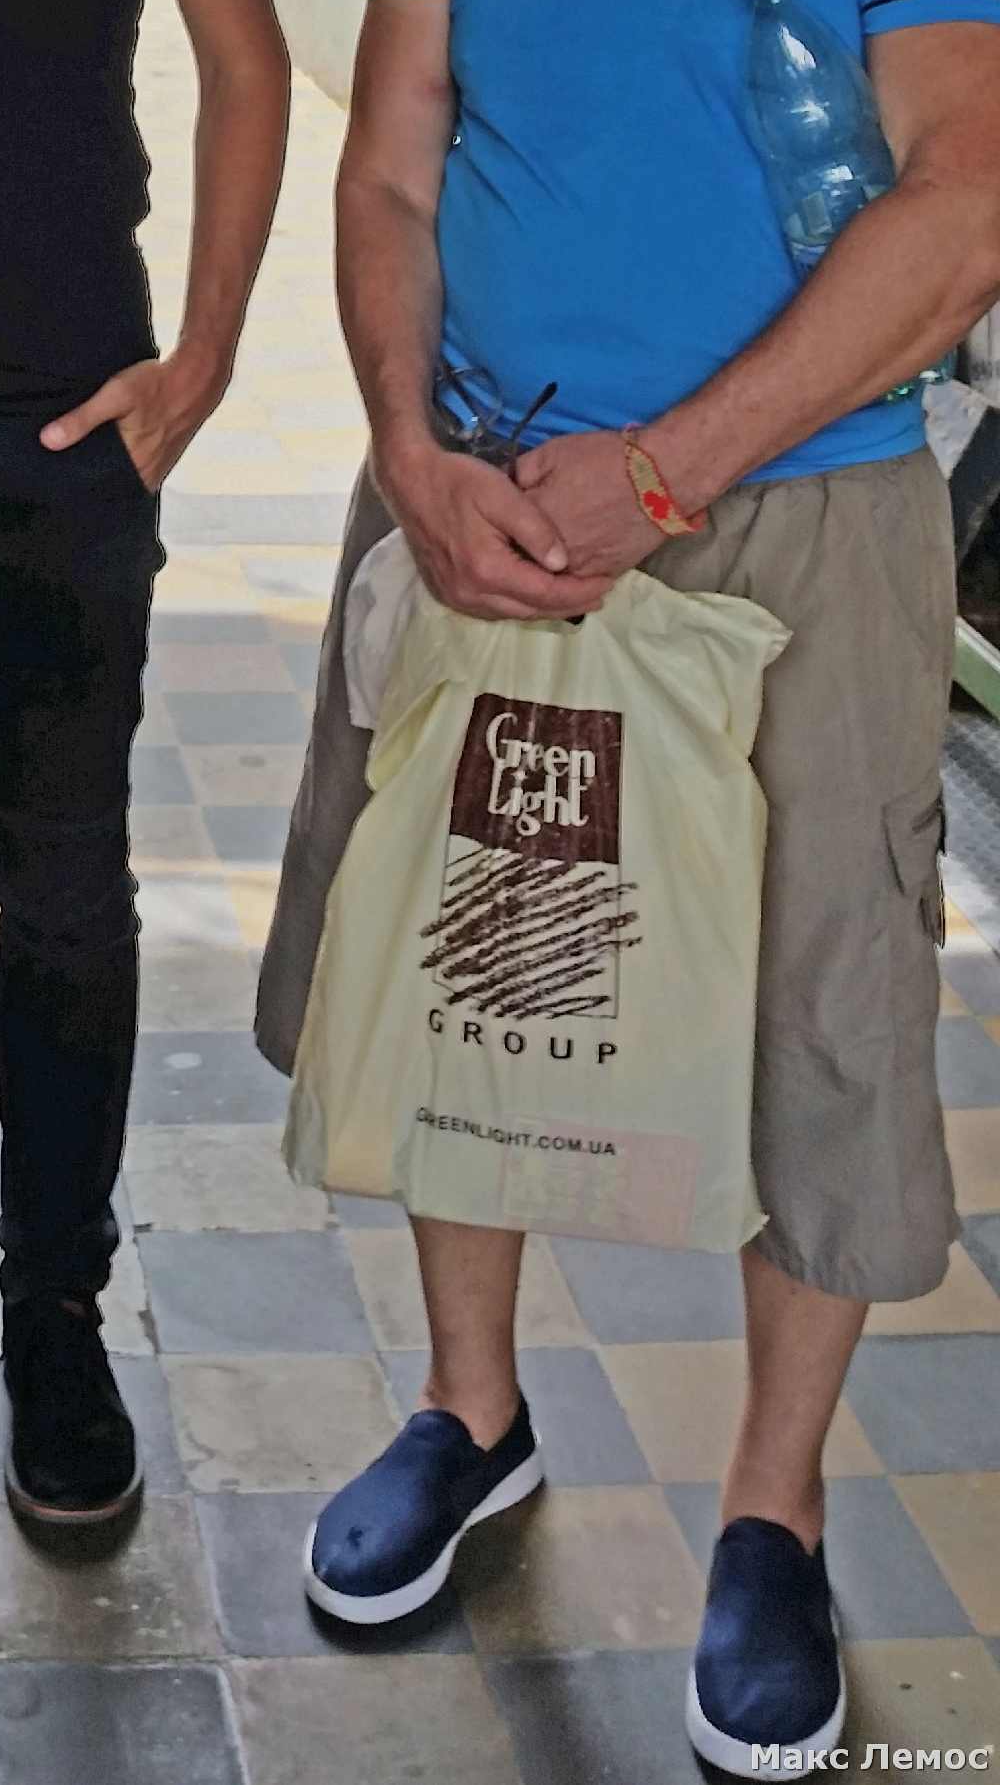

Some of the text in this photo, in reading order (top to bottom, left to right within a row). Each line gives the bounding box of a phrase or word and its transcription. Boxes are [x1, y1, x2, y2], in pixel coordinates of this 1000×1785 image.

[486, 712, 596, 777] Green
[487, 766, 595, 836] Light
[429, 1008, 618, 1064] GROUP
[416, 1106, 616, 1156] GREENLIGHT.COM.UA
